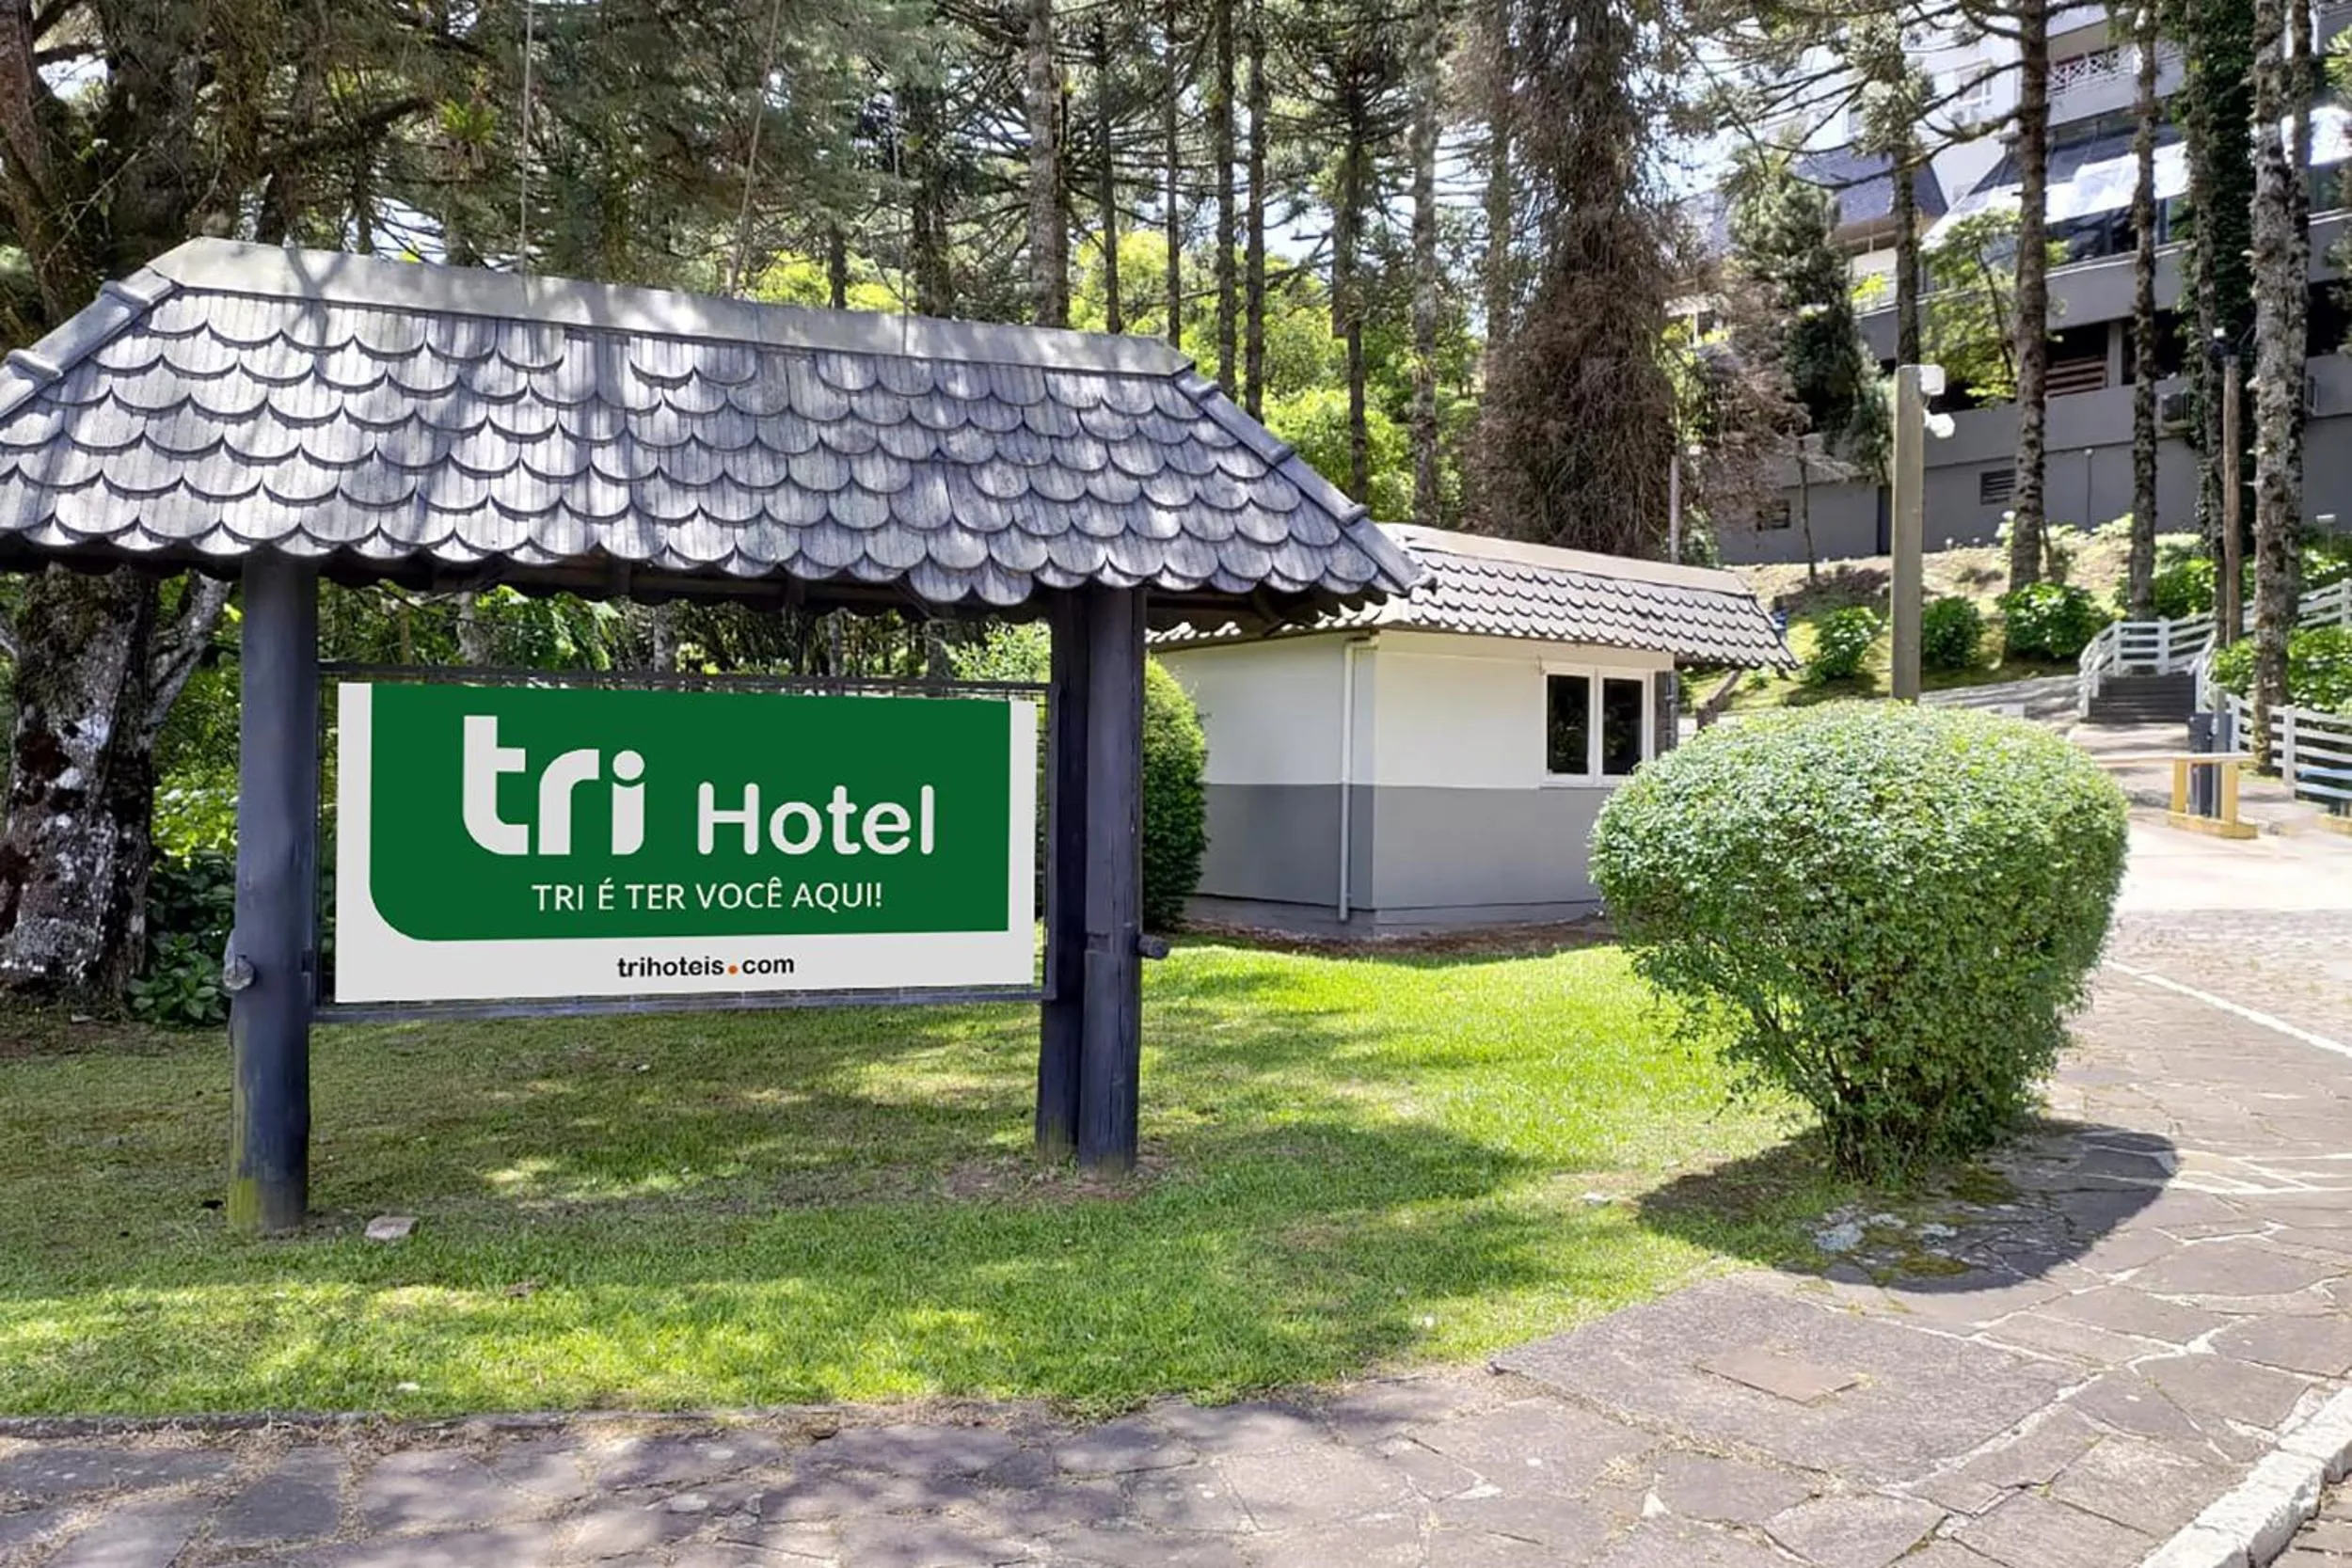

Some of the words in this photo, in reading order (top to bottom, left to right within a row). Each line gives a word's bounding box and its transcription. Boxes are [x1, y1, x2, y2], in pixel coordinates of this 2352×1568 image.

[462, 715, 645, 856] tri
[697, 782, 935, 856] Hotel
[532, 883, 583, 911] TRI
[597, 877, 614, 911] É
[624, 883, 685, 910] TER
[694, 876, 782, 910] VOCÊ
[792, 881, 882, 913] AQUI!
